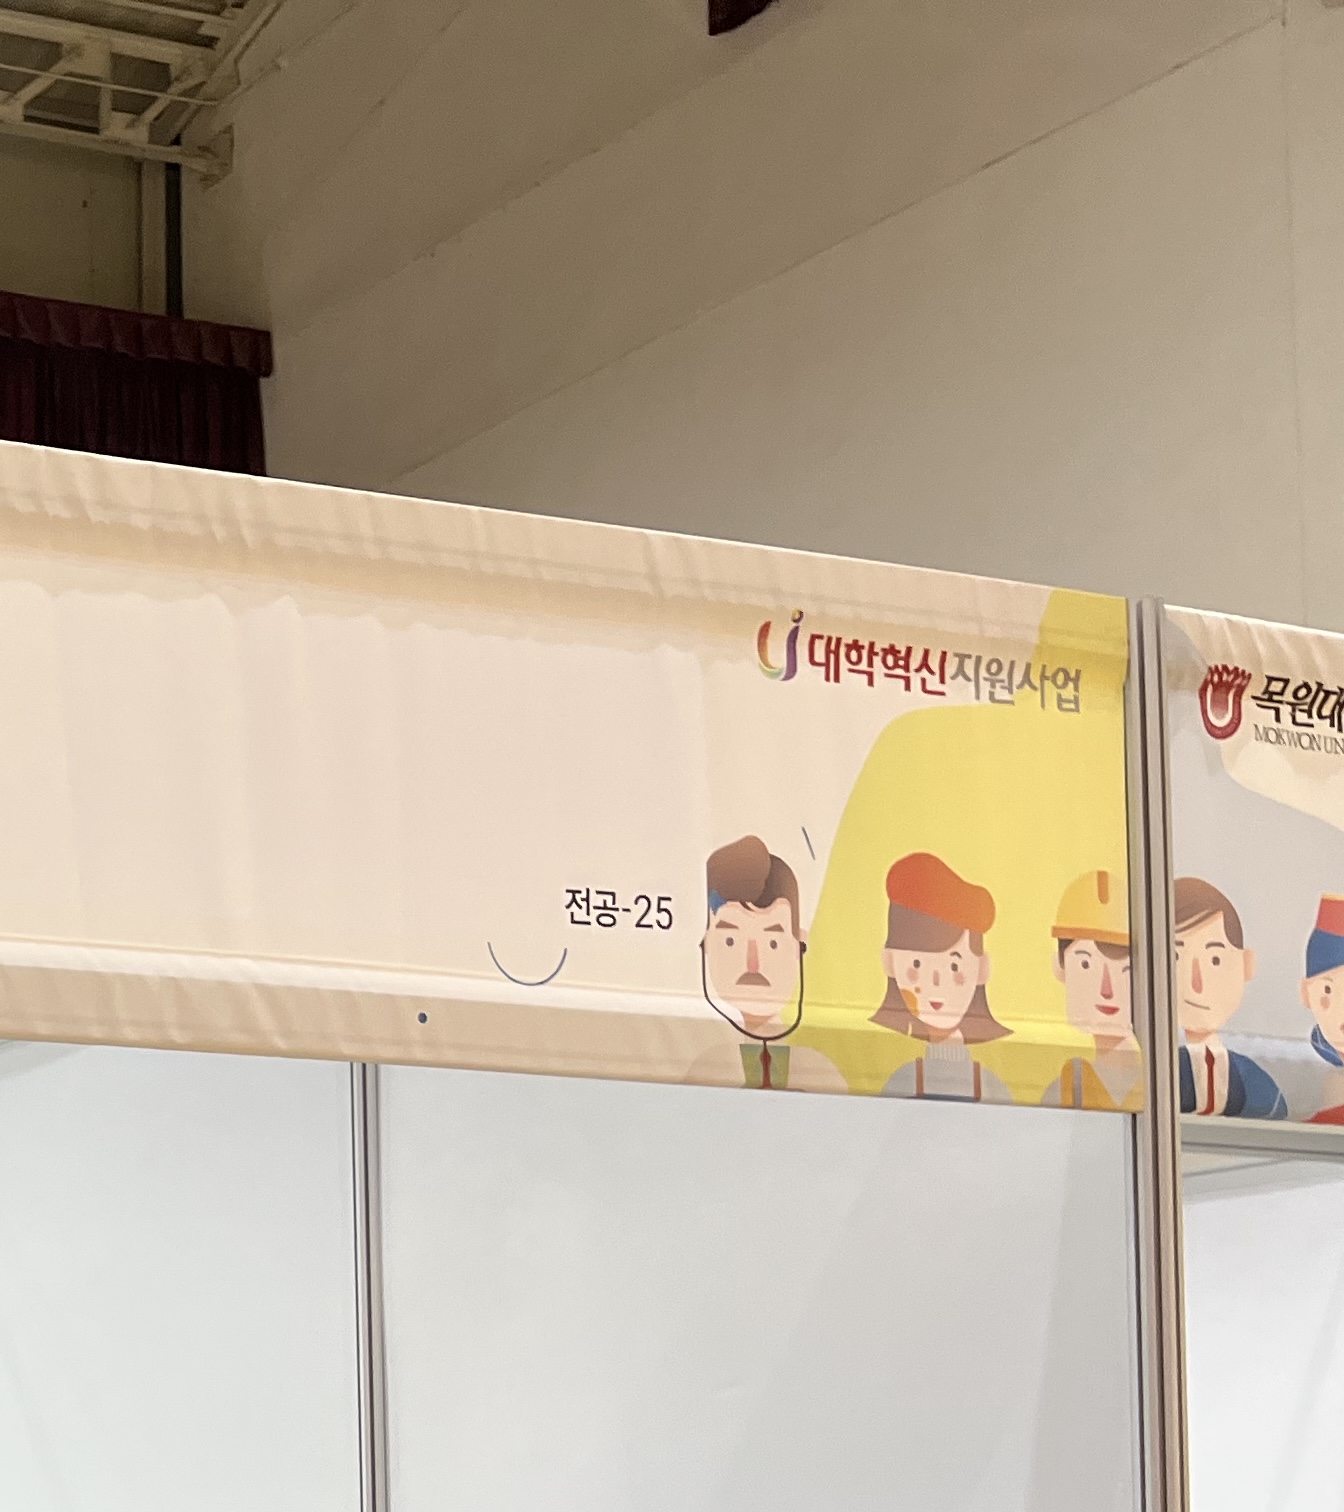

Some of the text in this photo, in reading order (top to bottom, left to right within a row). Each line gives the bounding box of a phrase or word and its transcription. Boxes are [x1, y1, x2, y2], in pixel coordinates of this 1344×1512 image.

[807, 633, 1083, 714] 대학혁신지원사업
[1250, 674, 1344, 734] 목원대
[1253, 723, 1322, 752] MOKWON
[564, 887, 673, 931] 전공-25
